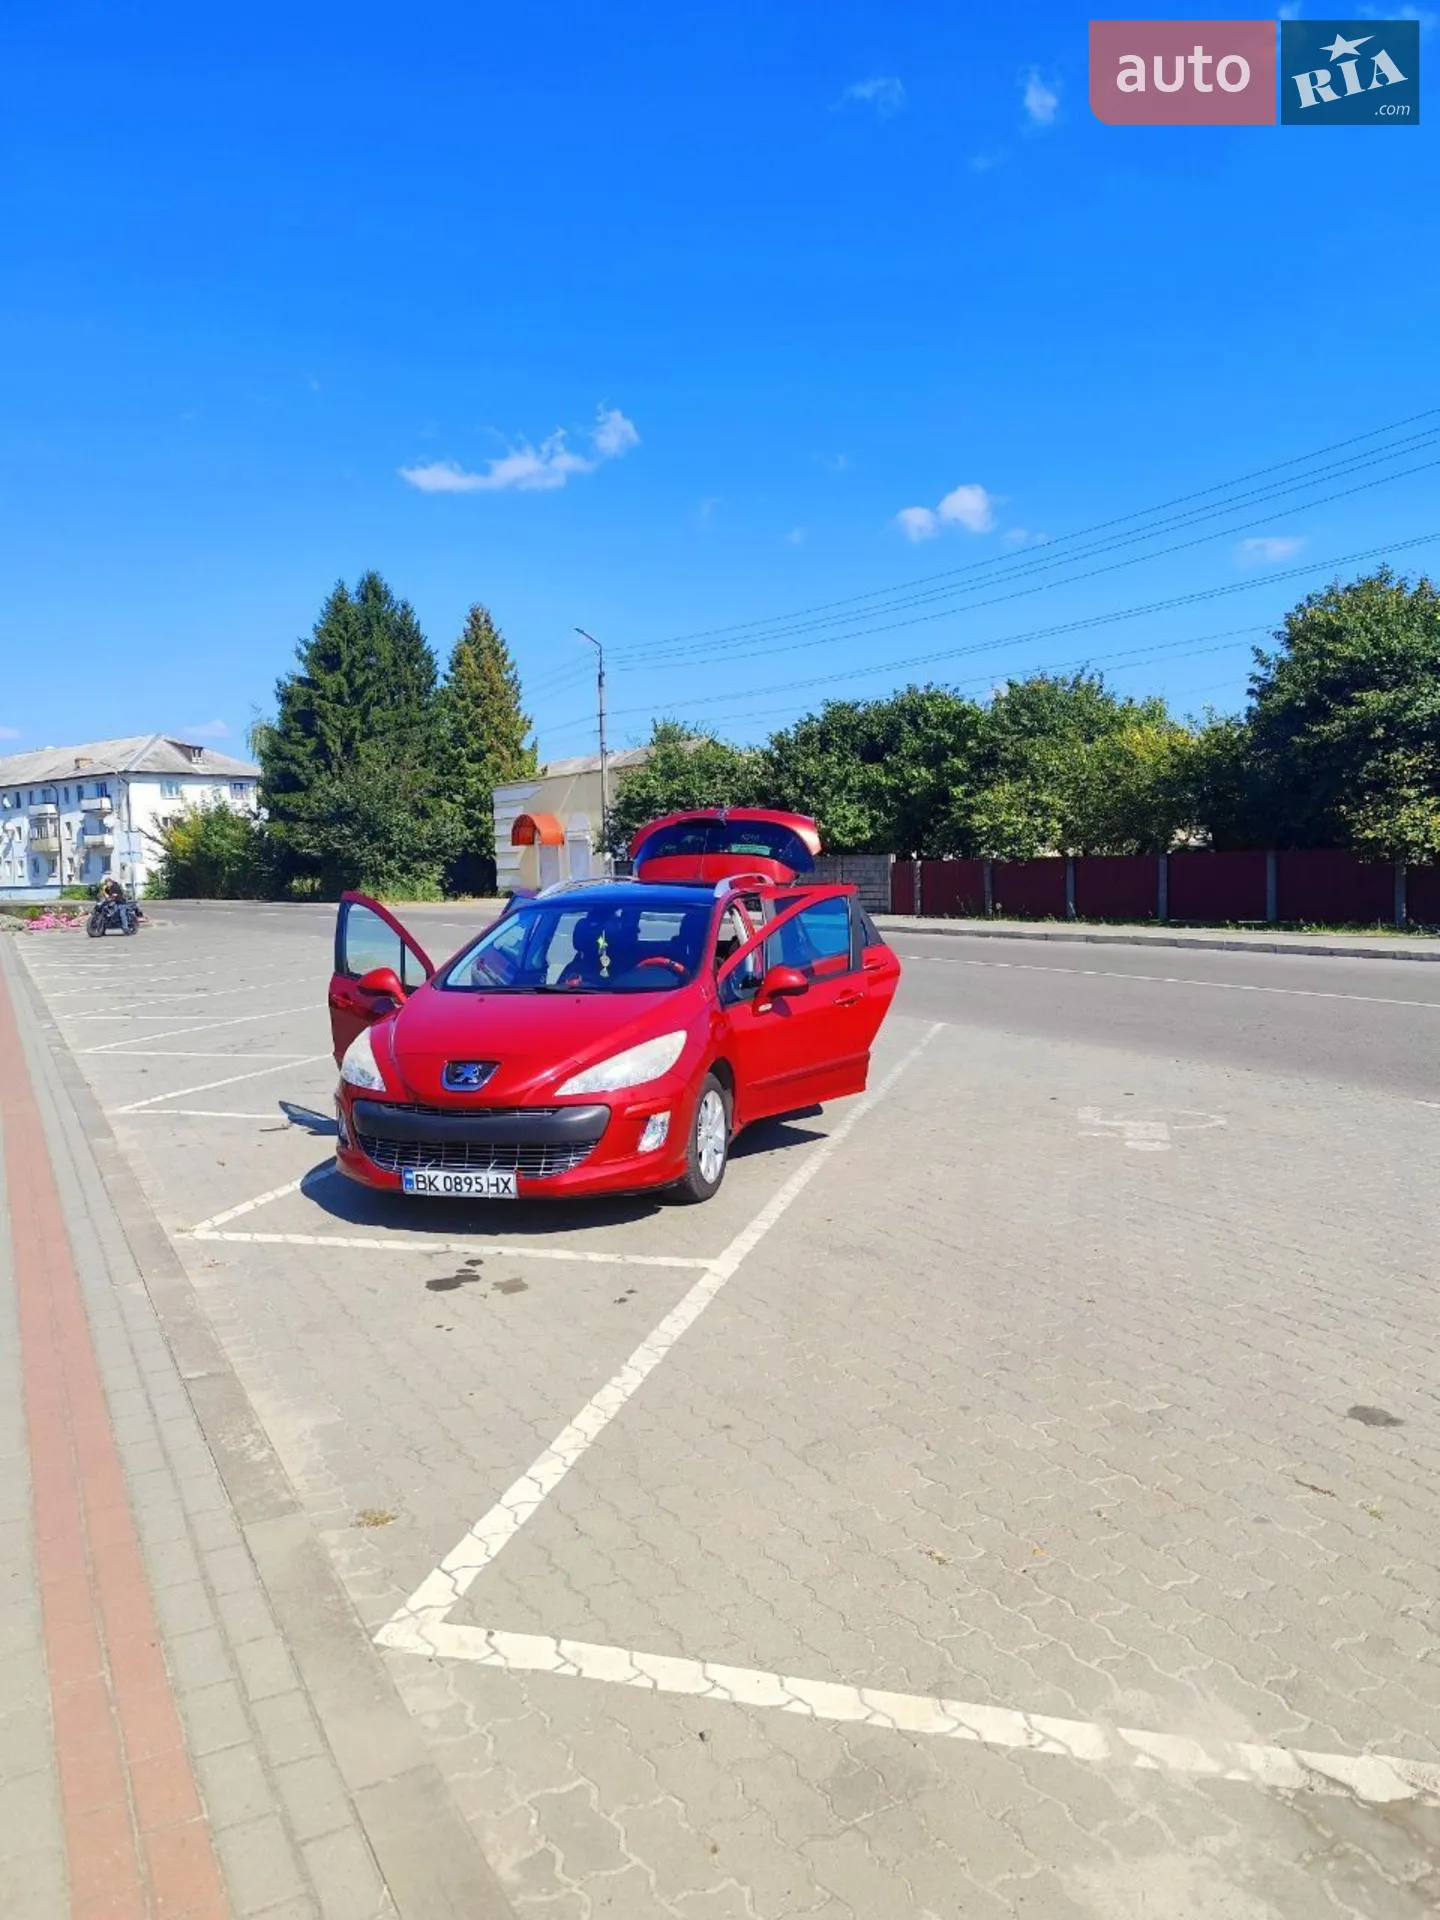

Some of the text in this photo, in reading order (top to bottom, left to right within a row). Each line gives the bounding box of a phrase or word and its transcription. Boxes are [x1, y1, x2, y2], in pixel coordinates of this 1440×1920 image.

[415, 1173, 513, 1194] BK 0895 HX
